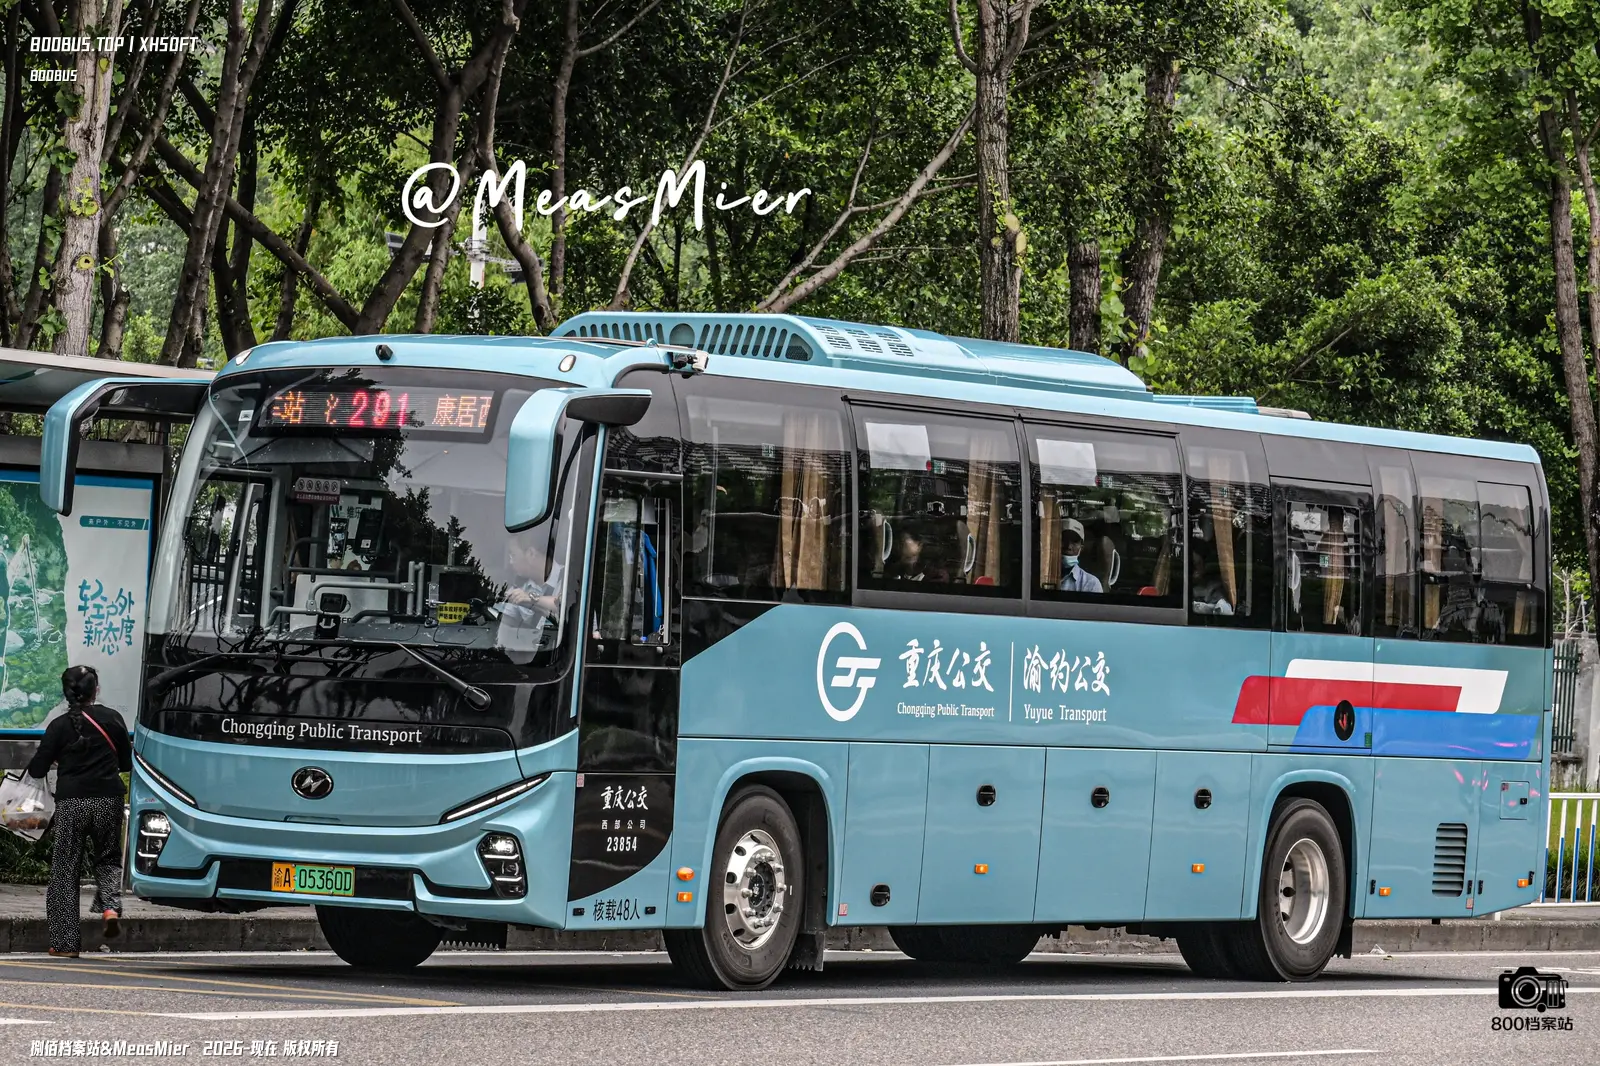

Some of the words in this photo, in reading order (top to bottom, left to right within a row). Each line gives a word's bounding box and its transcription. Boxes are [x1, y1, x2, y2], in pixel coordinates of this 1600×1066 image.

[349, 390, 409, 428] 291
[77, 578, 136, 622] 轻户外
[83, 614, 136, 656] 新态度
[898, 638, 995, 693] 重庆公交
[1023, 645, 1111, 697] 渝约公交
[897, 702, 936, 719] Chongqing
[937, 703, 959, 717] Public
[961, 704, 995, 719] Transport
[1023, 703, 1054, 724] Yuyue
[1059, 704, 1107, 726] Transport
[221, 718, 296, 740] Chongqing
[299, 722, 344, 740] Public
[348, 724, 423, 746] Transport
[601, 785, 649, 811] 重庆公交
[601, 819, 646, 830] 西部公司
[606, 836, 638, 852] 23854
[593, 899, 641, 921] 核载48人
